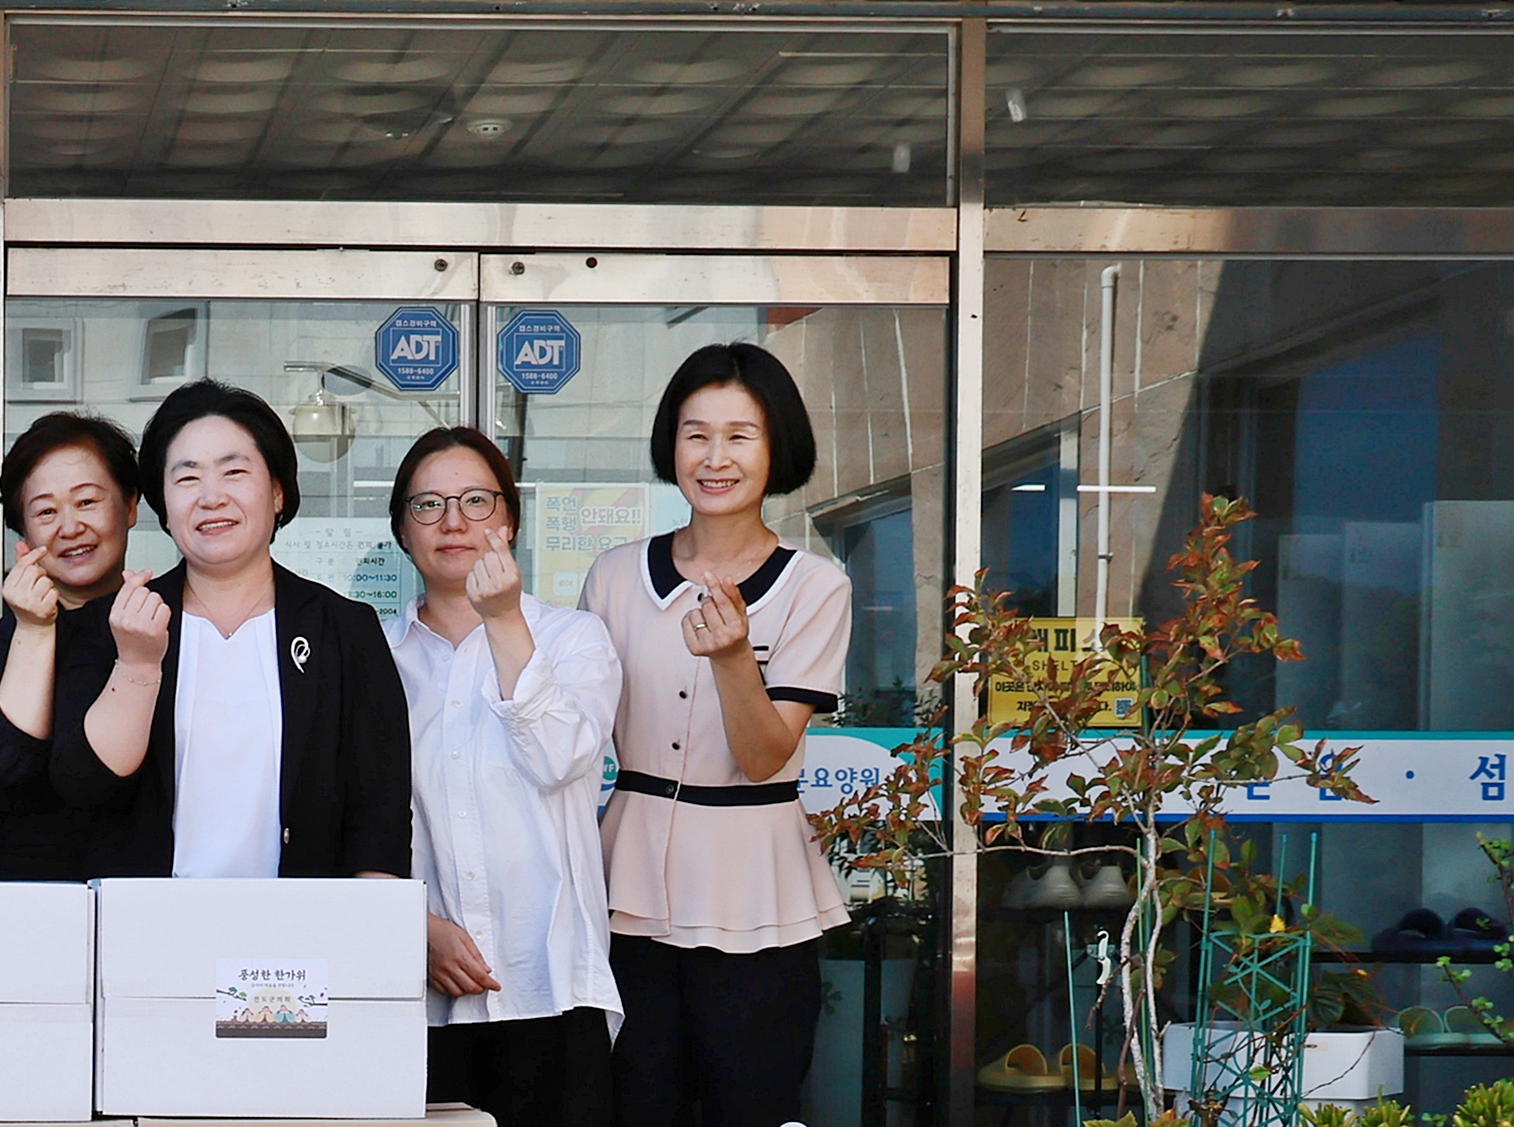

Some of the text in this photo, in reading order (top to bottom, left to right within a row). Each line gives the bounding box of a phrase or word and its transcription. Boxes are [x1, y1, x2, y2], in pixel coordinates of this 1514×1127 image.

[395, 319, 437, 327] 캡스경비구역
[390, 335, 442, 360] ADT
[514, 340, 565, 365] ADT
[398, 367, 434, 375] 1588-6400
[546, 496, 576, 511] 폭언
[546, 516, 576, 531] 폭행
[581, 508, 642, 524] 안돼요!!
[546, 536, 593, 551] 무리한
[995, 682, 1025, 692] 이곳은
[1469, 754, 1507, 801] 섬
[239, 969, 306, 981] 풍성한 한가위
